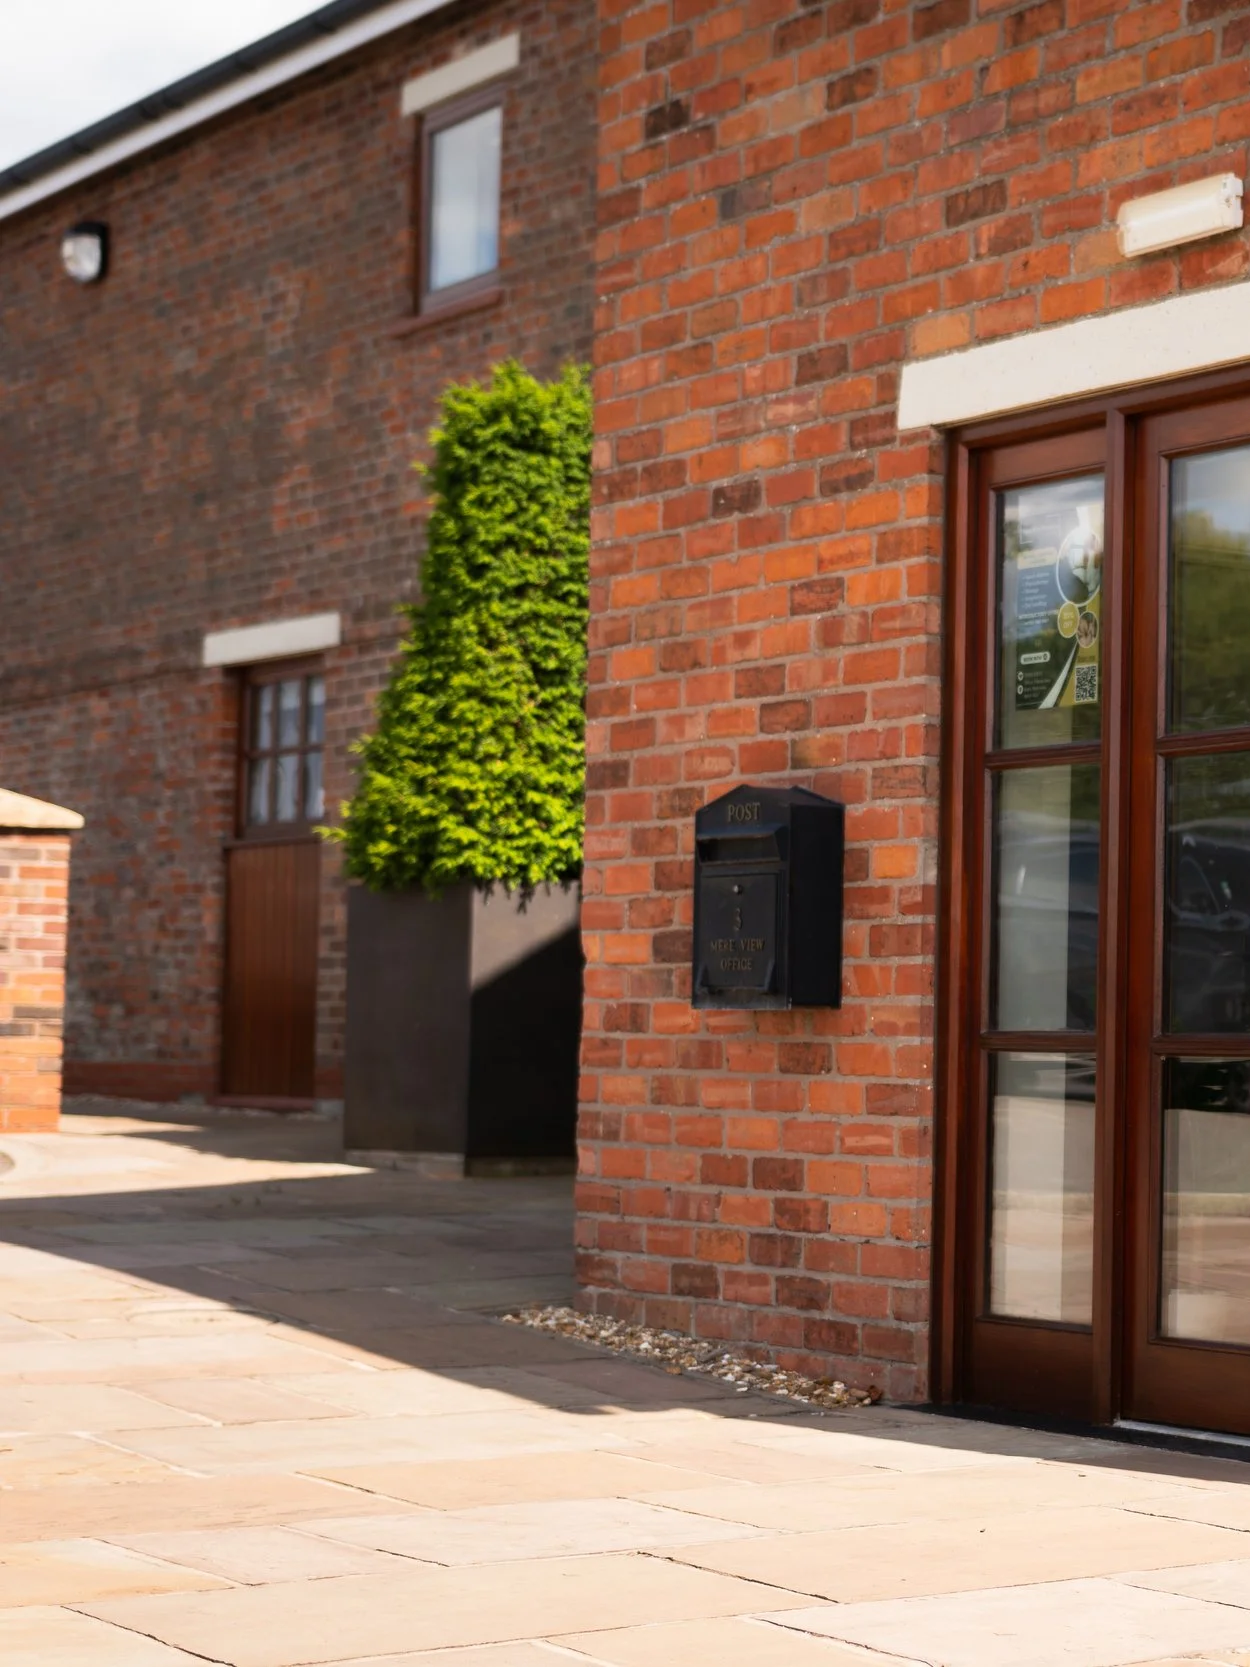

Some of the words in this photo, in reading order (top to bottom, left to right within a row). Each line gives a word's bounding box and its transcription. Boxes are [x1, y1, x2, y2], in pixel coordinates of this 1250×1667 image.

[727, 802, 761, 822] POST
[741, 937, 765, 951] VIEW
[720, 957, 753, 971] OFFICE
